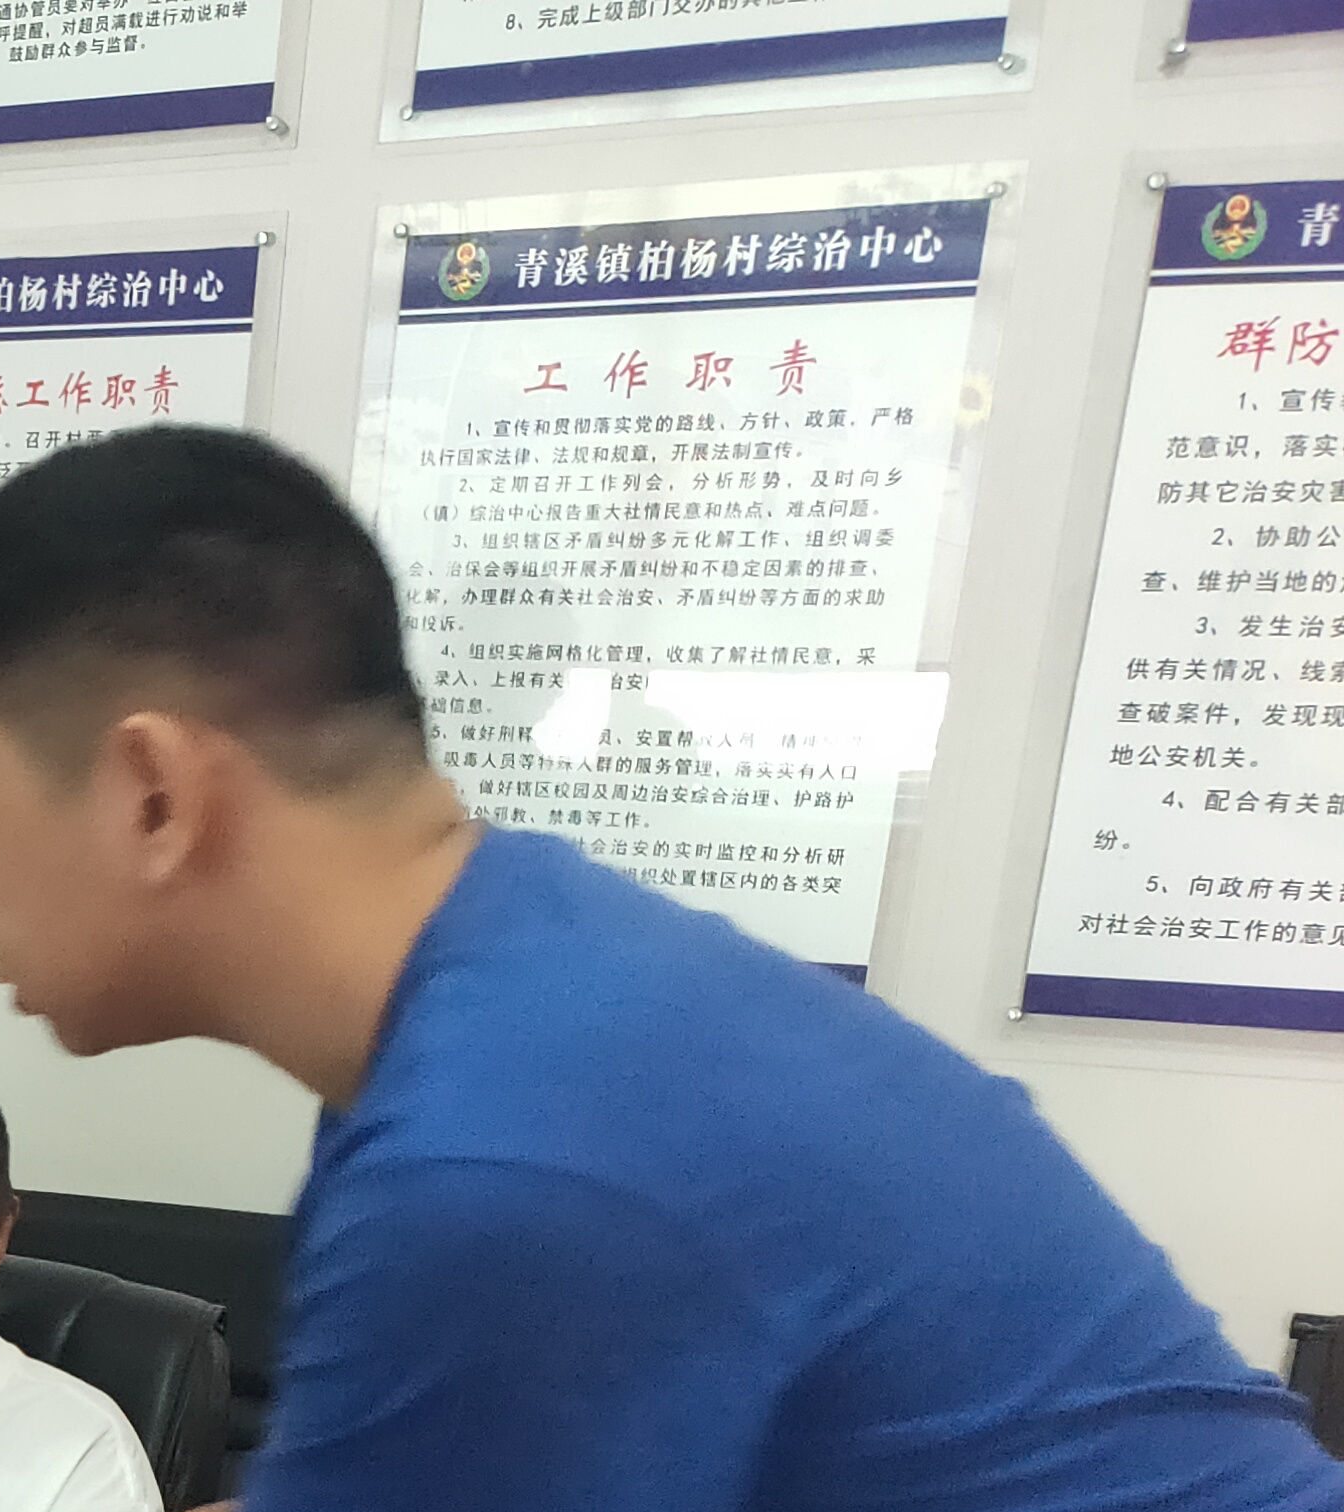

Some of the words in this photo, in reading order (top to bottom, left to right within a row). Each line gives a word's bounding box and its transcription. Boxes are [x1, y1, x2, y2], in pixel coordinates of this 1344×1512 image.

[1300, 202, 1339, 246] 青
[514, 223, 943, 287] 青溪镇柏杨村综治中心
[1217, 316, 1340, 373] 群防
[523, 340, 817, 399] 工作职责
[1239, 388, 1344, 412] 1、宣传
[1166, 434, 1344, 458] 范意识，落实
[1141, 570, 1344, 592] 查、维护当地的
[1109, 744, 1257, 768] 地公安机关。
[1093, 829, 1129, 850] 纷。
